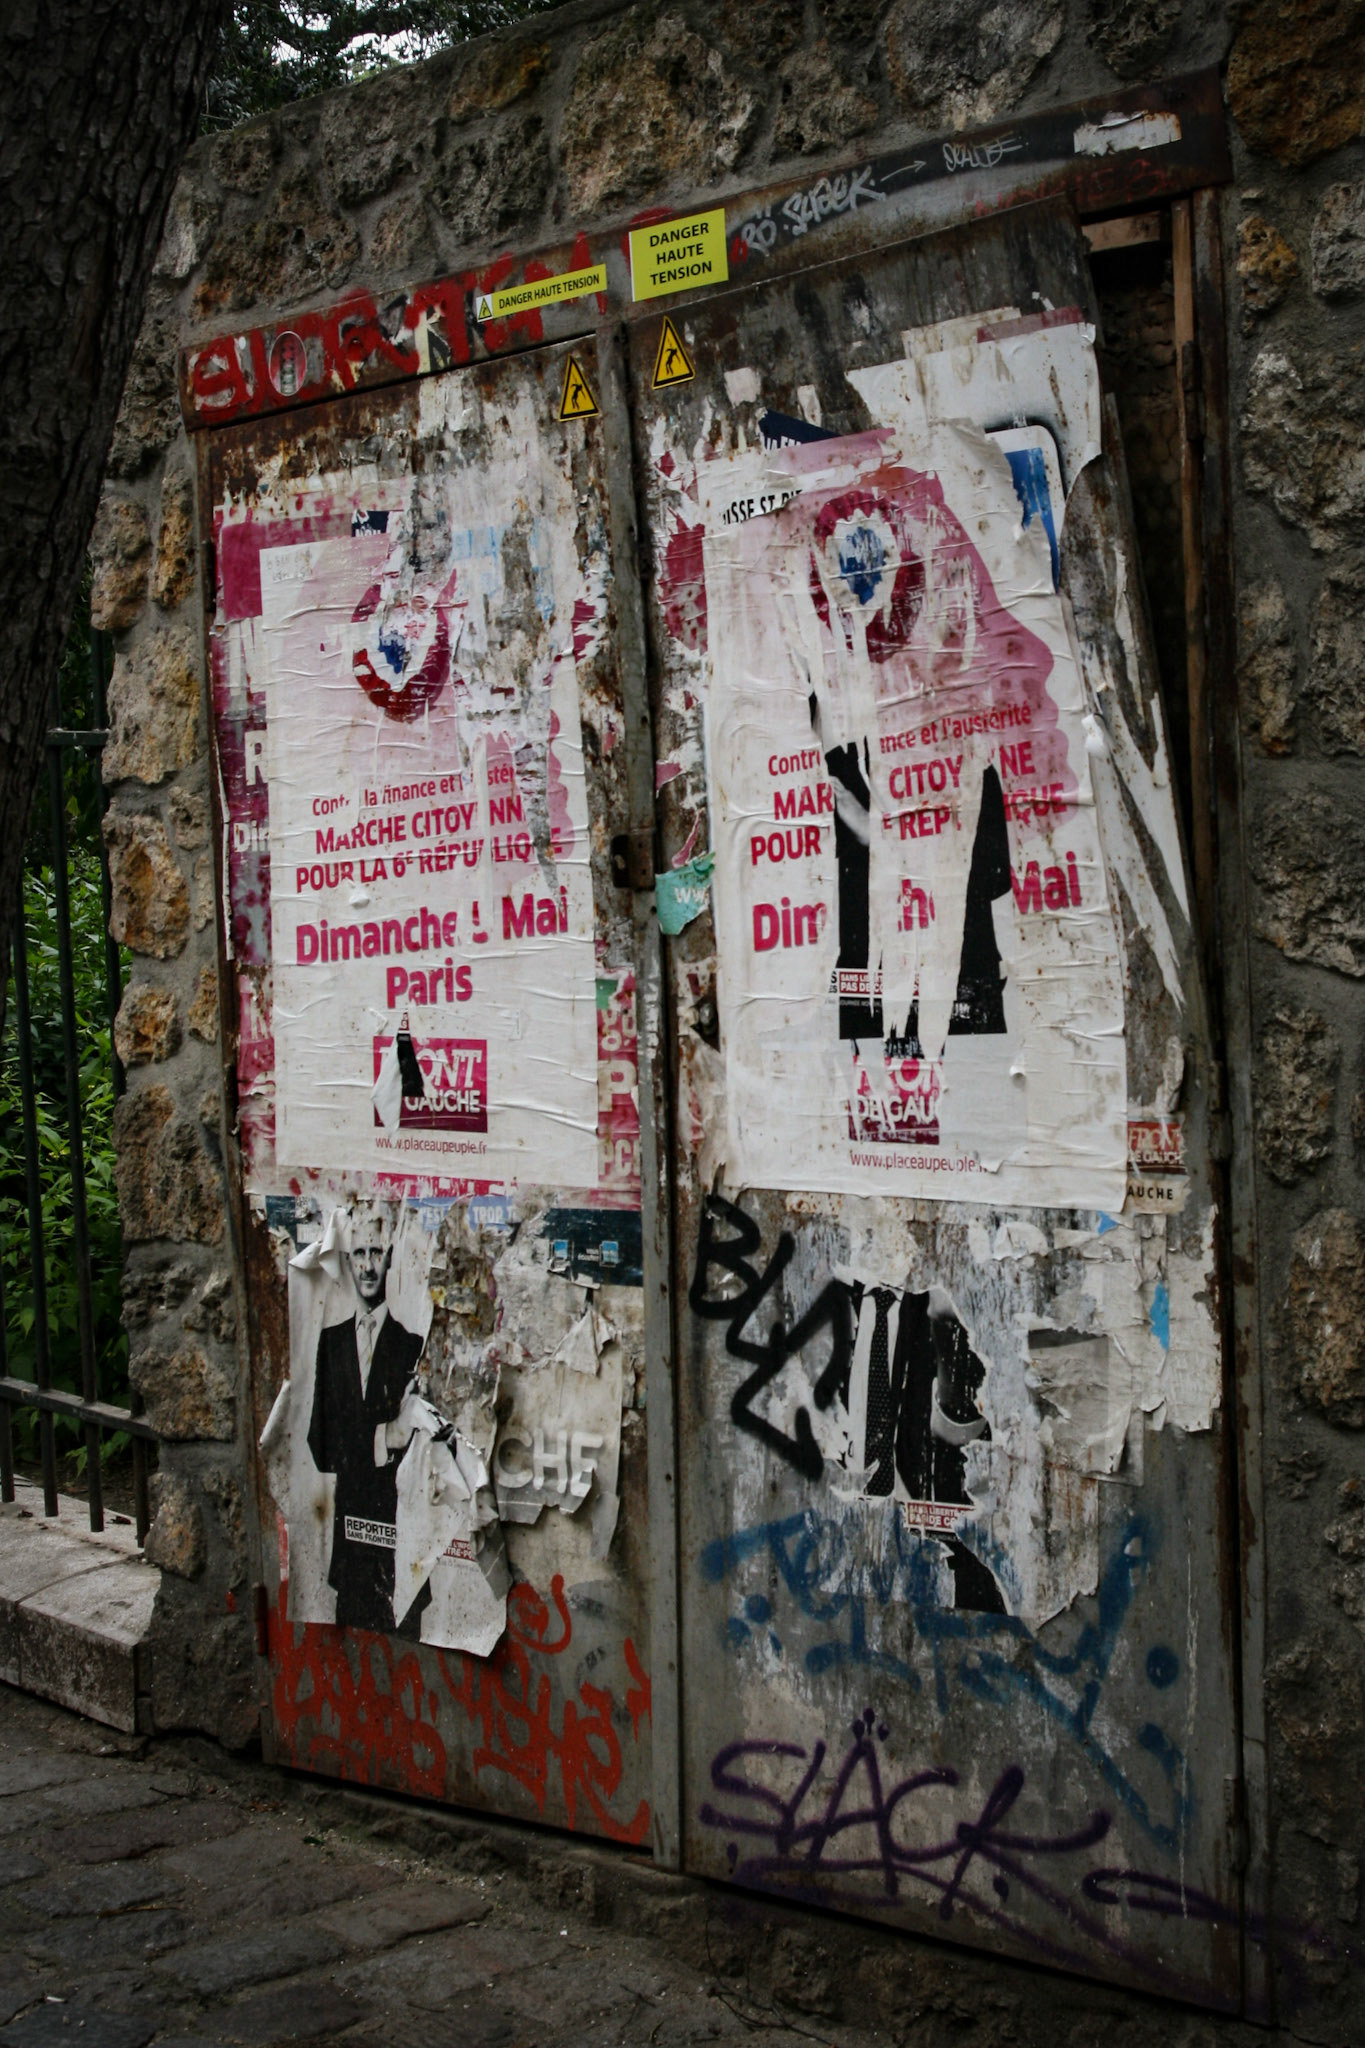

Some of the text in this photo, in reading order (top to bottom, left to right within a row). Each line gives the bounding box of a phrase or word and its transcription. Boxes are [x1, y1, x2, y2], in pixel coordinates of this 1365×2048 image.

[650, 222, 709, 247] DANGER
[656, 243, 704, 265] HAUTE
[651, 261, 712, 286] TENSION
[499, 273, 599, 309] DANGER HAUTE TENSION
[921, 726, 938, 746] et
[364, 789, 378, 806] la
[440, 775, 457, 793] et
[315, 813, 406, 854] MARCHE
[751, 825, 822, 865] POUR
[296, 862, 354, 893] POUR
[360, 856, 388, 883] LA
[1010, 851, 1081, 914] Mai
[296, 906, 458, 966] Dimanche
[503, 885, 568, 940] Mai
[386, 957, 472, 1009] Paris
[376, 1137, 487, 1155] ww.placeaupeuple.fr
[1127, 1185, 1173, 1200] AUCHE
[493, 1425, 604, 1498] CHE
[346, 1518, 397, 1538] REPORTER
[346, 1529, 397, 1546] SANS FRONTIER
